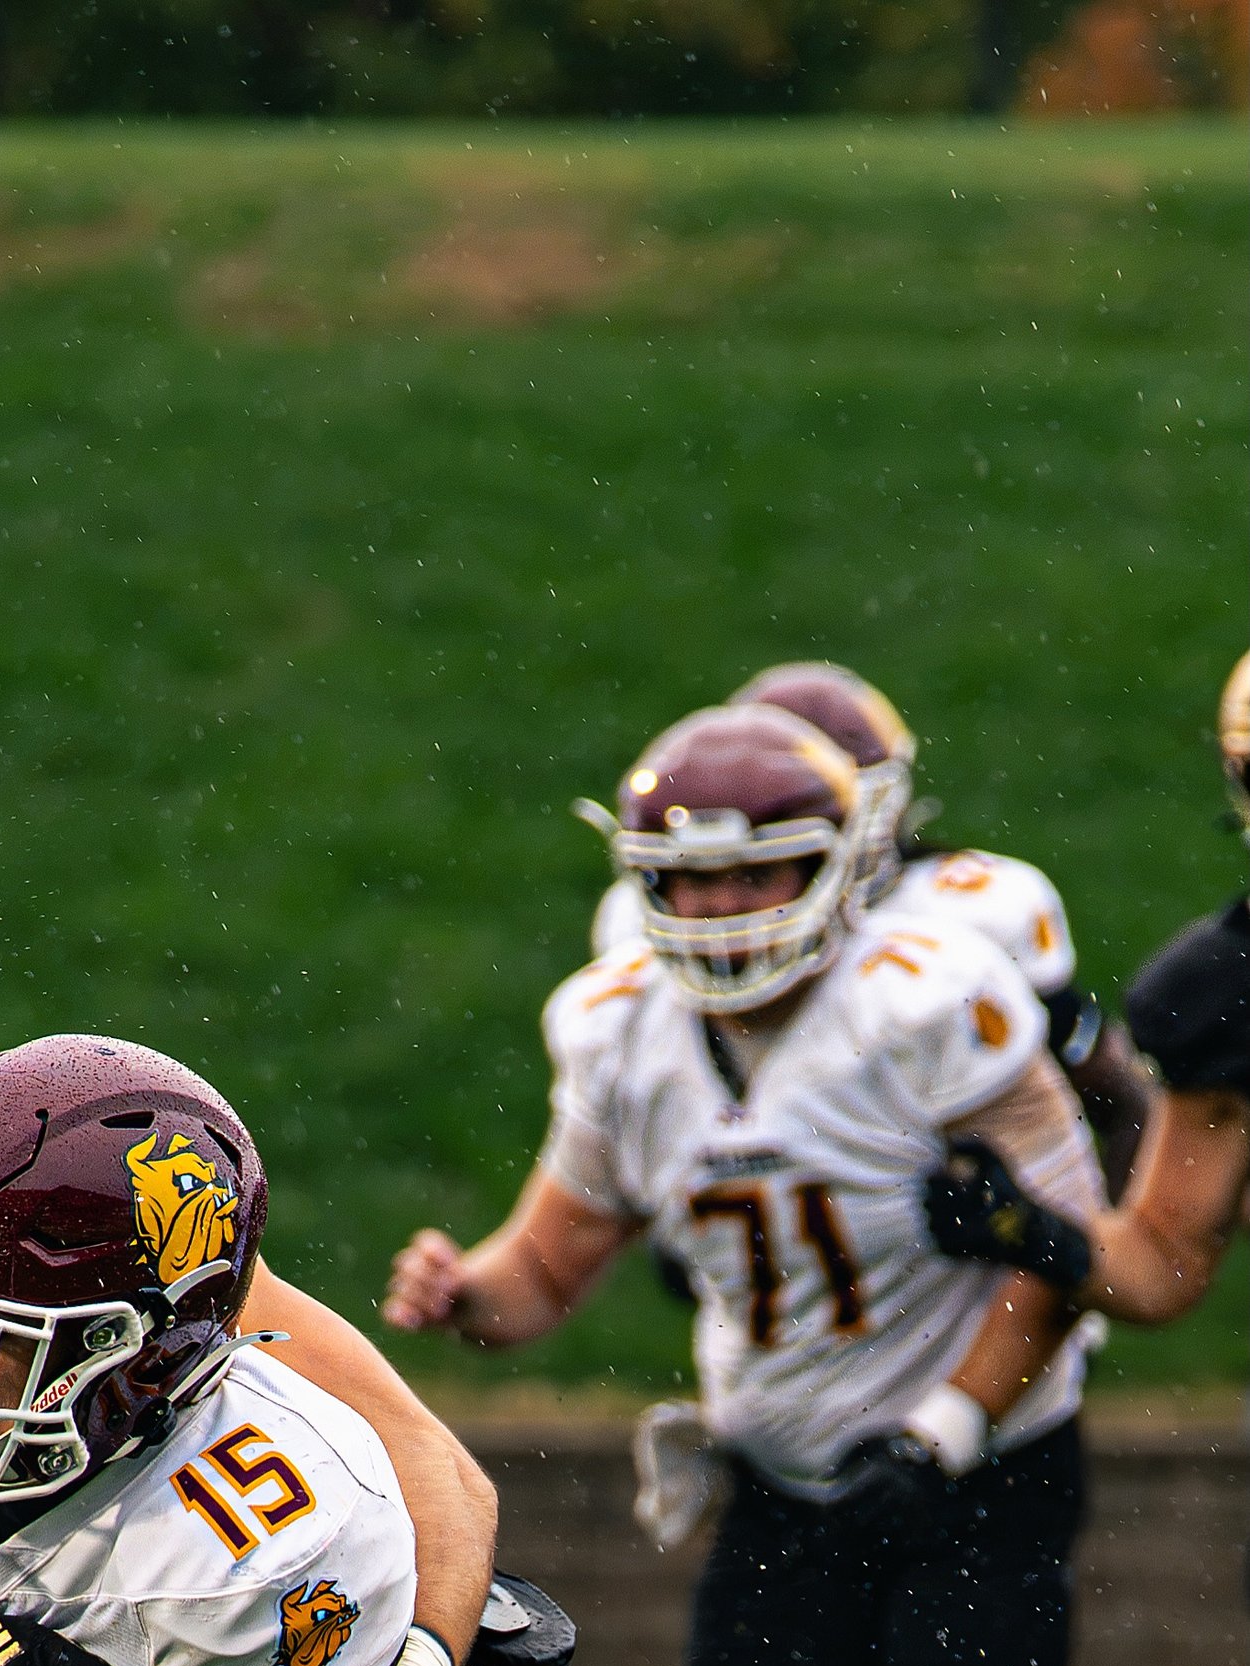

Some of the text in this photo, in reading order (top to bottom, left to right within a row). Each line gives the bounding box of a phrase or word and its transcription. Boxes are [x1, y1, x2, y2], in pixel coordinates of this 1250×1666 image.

[687, 1178, 872, 1348] 71
[30, 1372, 78, 1413] iddell
[168, 1423, 316, 1561] 15
